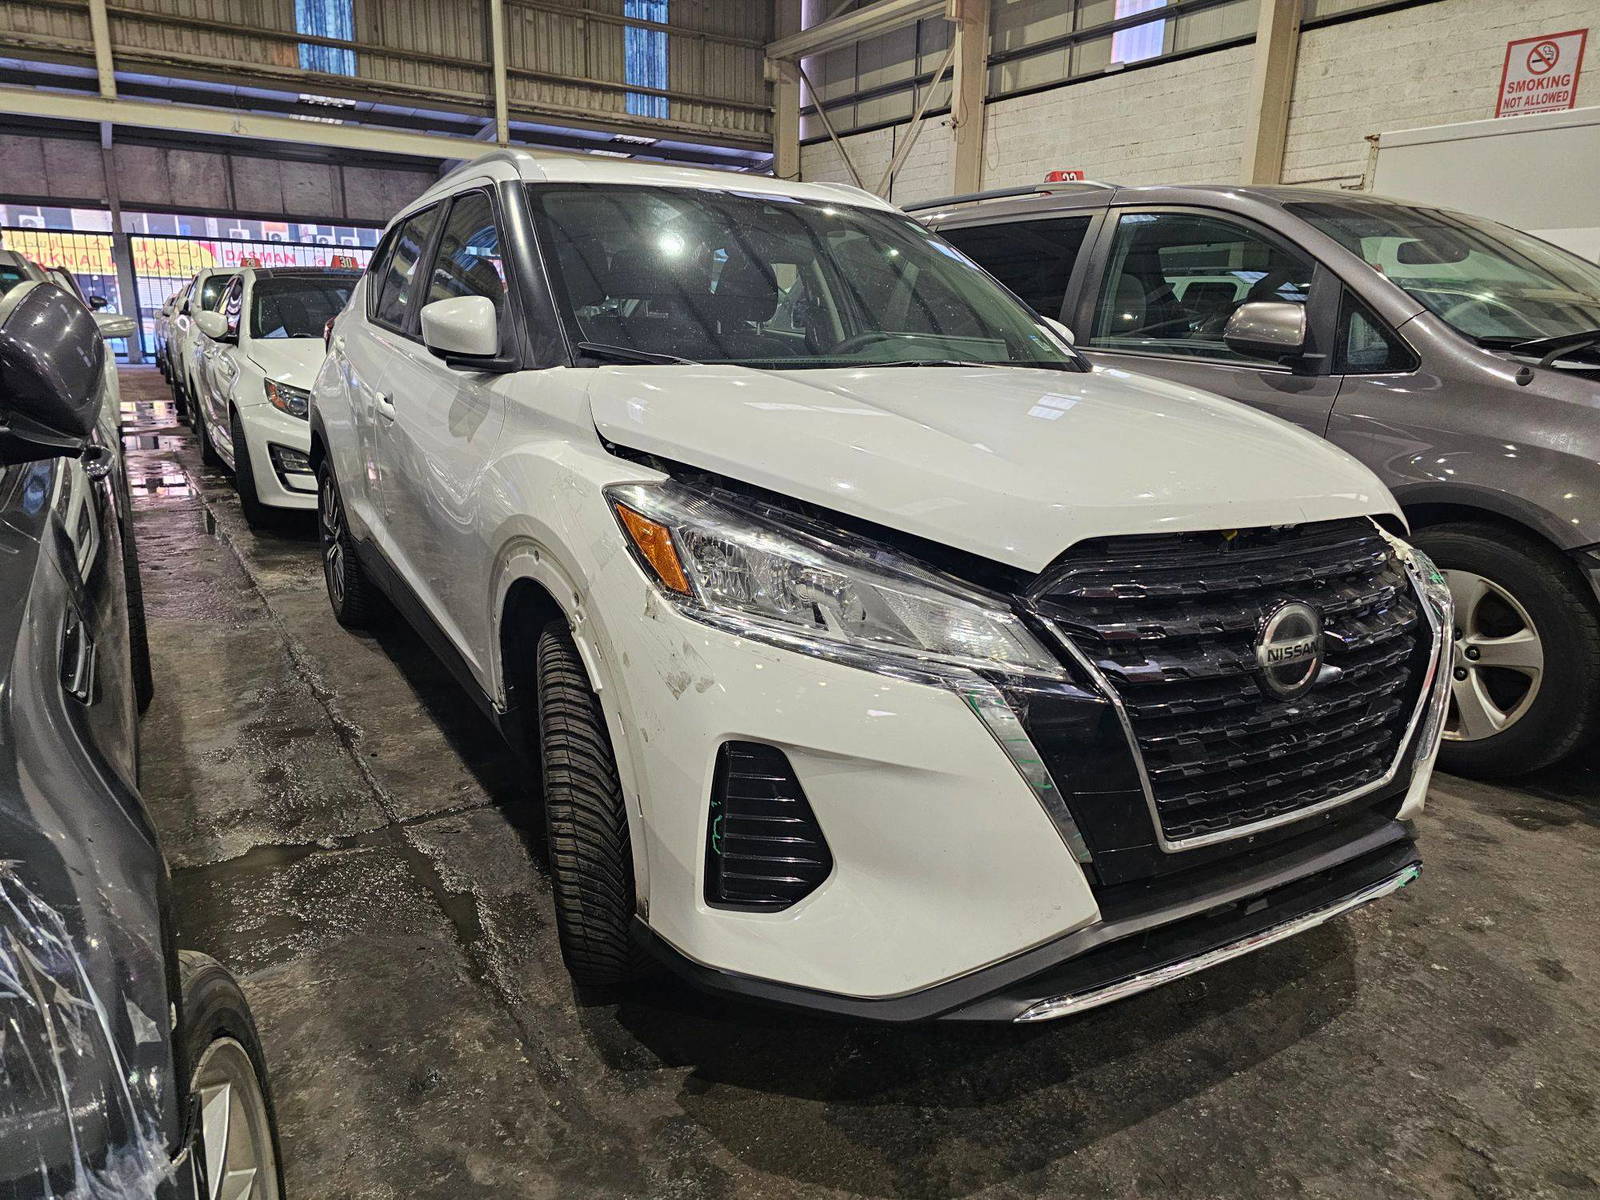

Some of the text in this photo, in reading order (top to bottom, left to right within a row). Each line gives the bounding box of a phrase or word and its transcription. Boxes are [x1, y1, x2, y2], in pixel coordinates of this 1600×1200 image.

[1507, 74, 1571, 94] SMOKING
[1503, 91, 1569, 109] NOT ALLOWED
[79, 254, 101, 267] AL
[340, 256, 352, 268] 30
[1267, 640, 1318, 662] NISSAN
